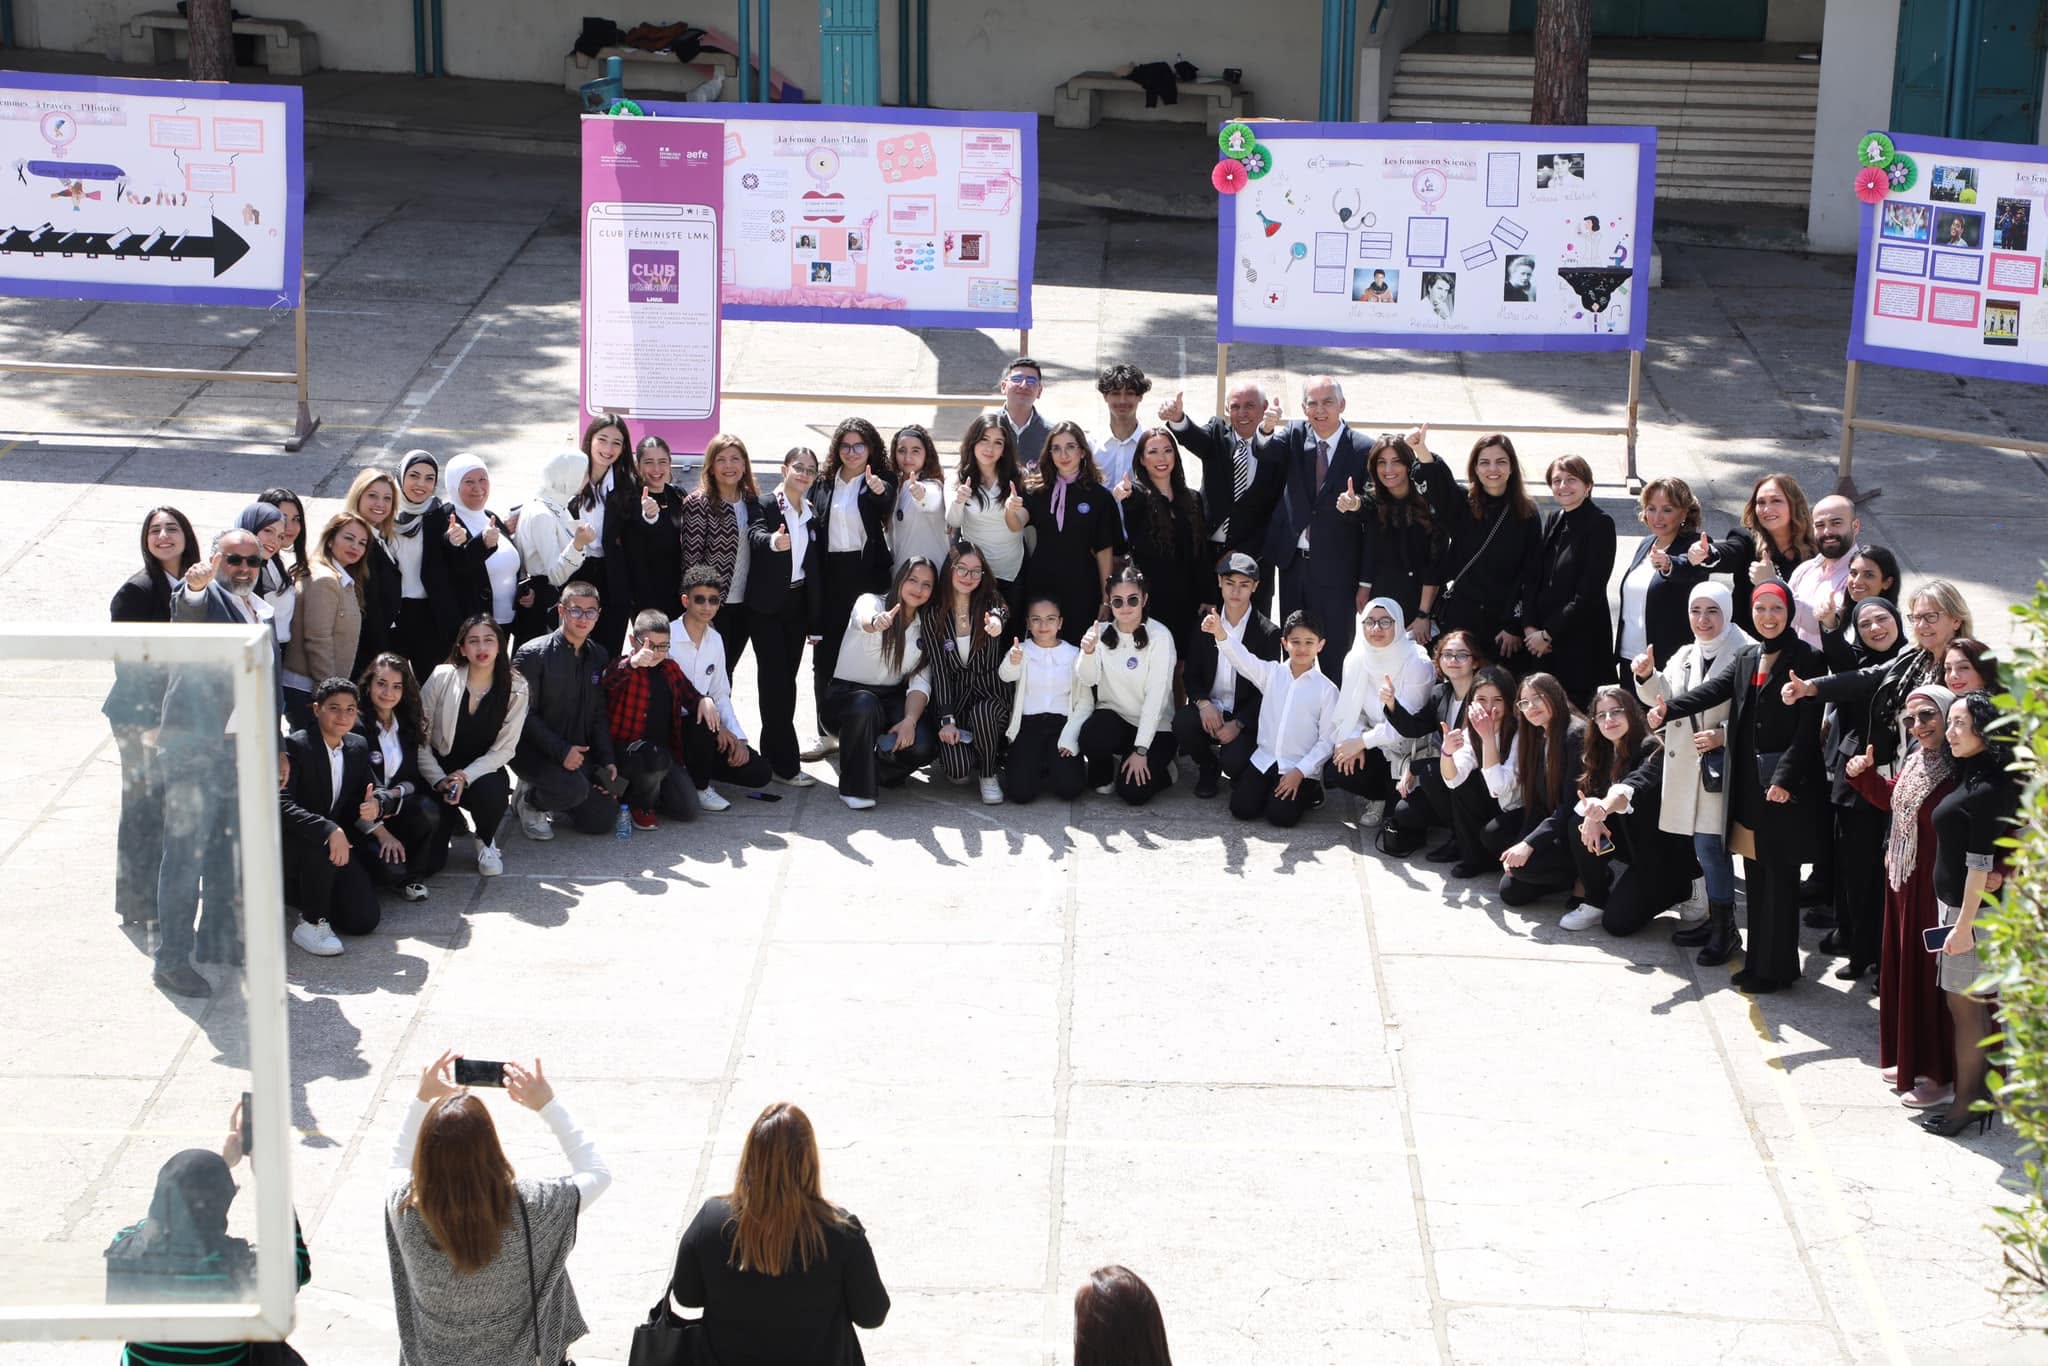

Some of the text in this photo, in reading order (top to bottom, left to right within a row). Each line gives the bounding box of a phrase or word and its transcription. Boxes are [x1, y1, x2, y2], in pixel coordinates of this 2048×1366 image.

[42, 102, 72, 110] travers
[81, 103, 121, 112] l'Histoire
[821, 136, 840, 144] dans
[686, 150, 708, 159] aefe
[1443, 158, 1477, 167] Sciences
[2017, 172, 2030, 181] Les
[599, 227, 709, 240] CLUB FÉMINISTE LMK
[632, 264, 676, 277] CLUB
